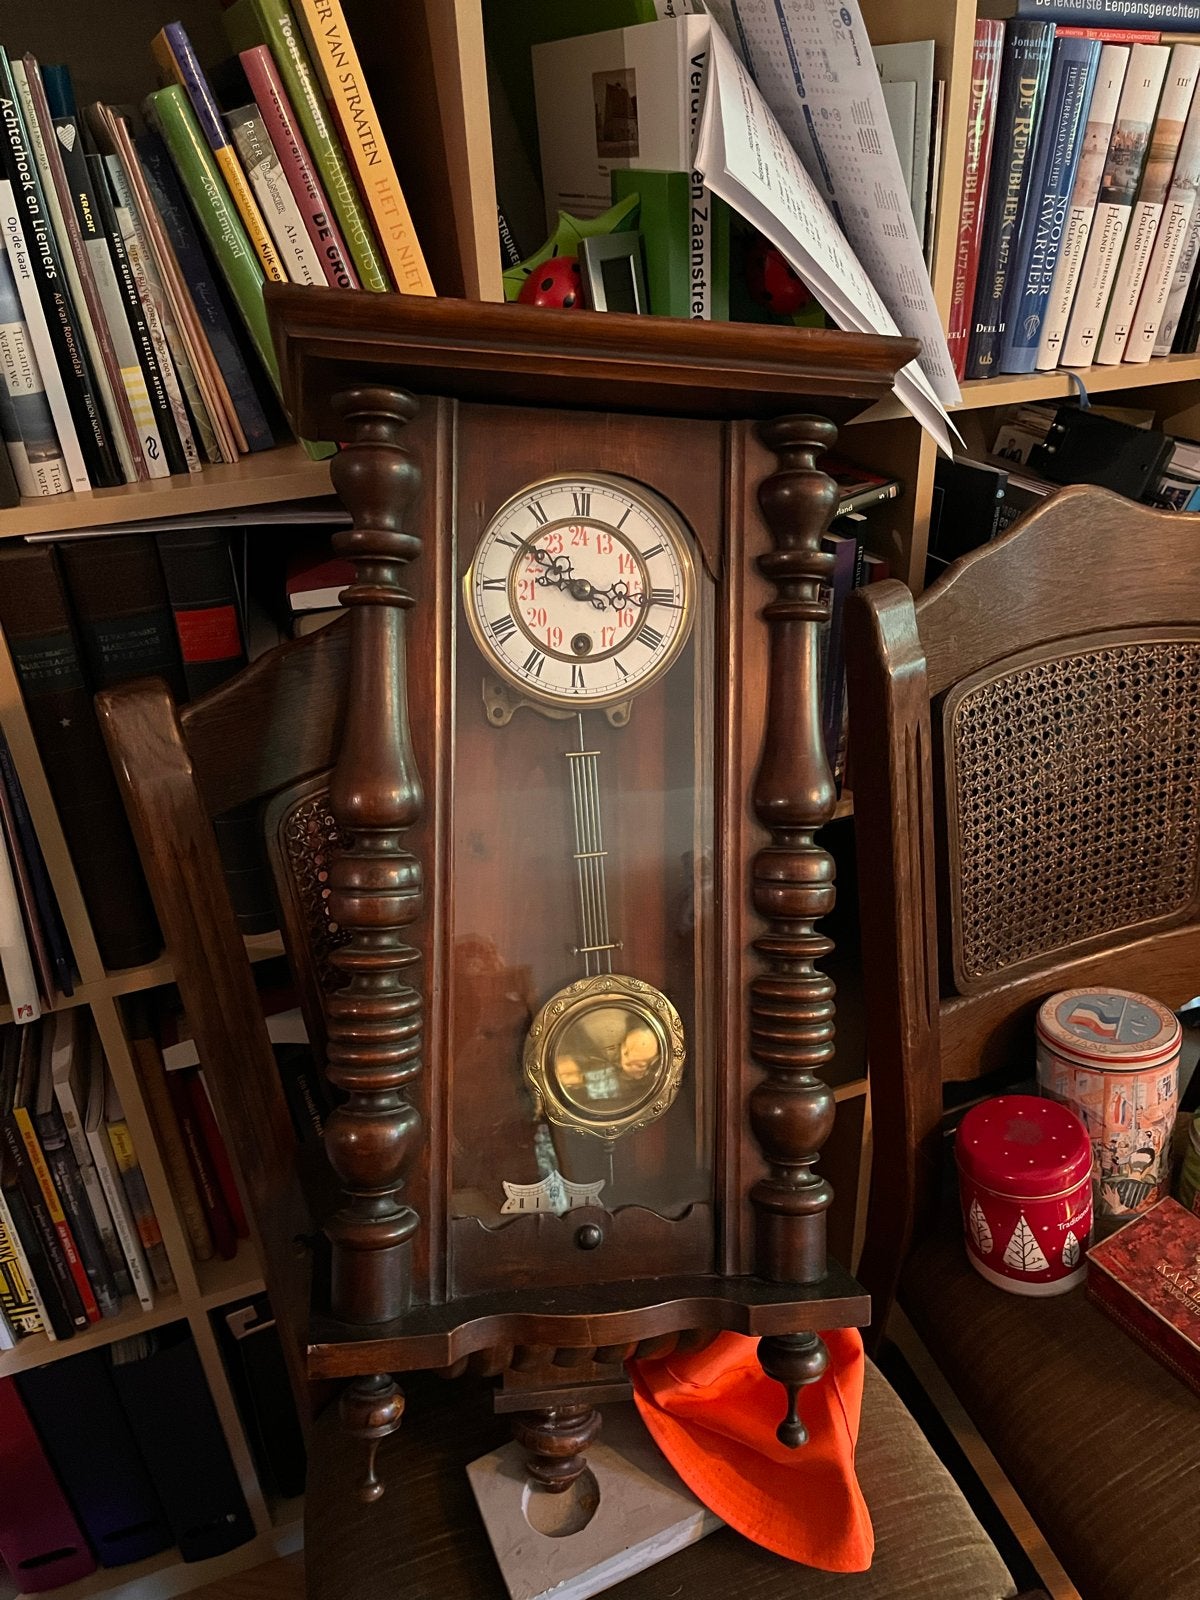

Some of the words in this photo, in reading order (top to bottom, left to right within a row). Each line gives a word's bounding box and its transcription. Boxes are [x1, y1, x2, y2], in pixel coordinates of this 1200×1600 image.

[1053, 0, 1102, 10] lekkerste
[1105, 0, 1200, 18] Eenpansgerechten
[1068, 66, 1077, 88] HET
[970, 79, 988, 110] DE
[1016, 76, 1038, 110] DE
[1058, 90, 1072, 142] VERRAAD
[1, 98, 34, 191] Achterhoek
[278, 14, 300, 59] Toon
[323, 149, 368, 246] VANDAAG
[362, 248, 379, 270] IS
[324, 25, 349, 68] VAN
[339, 73, 382, 166] STRAATEN
[375, 177, 399, 216] HET
[390, 224, 406, 240] IS
[398, 245, 422, 288] NIET
[1054, 143, 1063, 164] VAN
[961, 117, 985, 235] REPUBLIEK
[1001, 117, 1029, 230] REPUBLIEK
[1050, 166, 1059, 188] HET
[26, 194, 40, 215] en
[241, 119, 265, 157] PETER
[258, 160, 288, 215] BLANKER
[283, 222, 299, 244] Als
[293, 246, 306, 261] de
[7, 216, 17, 233] Op
[79, 193, 96, 233] KRACHT
[290, 139, 302, 162] van
[311, 210, 333, 241] DE
[325, 244, 353, 289] GRO
[1162, 202, 1183, 250] HOLLAND
[13, 235, 22, 249] de
[211, 207, 247, 259] Ermgard
[1098, 205, 1118, 254] HOLLAND
[1133, 204, 1153, 252] HOLLAND
[32, 219, 57, 279] Liemers
[110, 231, 125, 259] ARNON
[259, 242, 276, 264] Kijk
[1025, 193, 1055, 298] KWARTIER
[1038, 194, 1067, 298] NOORDER
[1099, 219, 1122, 290] GESCHIEDENIS
[1133, 217, 1156, 287] GESCHIEDENIS
[1162, 216, 1186, 286] GESCHIEDENIS
[17, 252, 31, 279] kaart
[952, 239, 969, 305] 1477-1806
[991, 234, 1011, 300] 1477-1806
[54, 292, 63, 305] Ad
[118, 263, 139, 305] GRUNBERG
[1128, 288, 1136, 306] VAN
[1156, 286, 1165, 304] VAN
[140, 287, 160, 329] VERLOREN
[1094, 291, 1103, 308] VAN
[59, 306, 68, 324] van
[136, 320, 145, 331] DE
[976, 323, 997, 333] DEEL
[999, 323, 1006, 332] II
[0, 330, 16, 368] waren
[10, 370, 20, 388] we
[13, 327, 34, 389] Titaantjes
[63, 325, 85, 378] Roosendaal
[139, 335, 157, 370] HEILIGE
[84, 394, 94, 418] TIRION
[151, 374, 168, 409] ANTONIO
[91, 419, 104, 447] NATUUR
[572, 493, 590, 516] XII
[544, 534, 564, 554] 23
[568, 526, 590, 546] 24
[596, 534, 614, 554] 13
[618, 554, 637, 574] 14
[518, 581, 536, 600] 21
[527, 608, 546, 627] 20
[617, 608, 634, 628] 16
[546, 626, 563, 648] 19
[601, 626, 617, 648] 17
[522, 648, 546, 678] VII
[572, 664, 585, 688] VI
[3, 1126, 15, 1145] ANNE
[10, 1144, 24, 1167] FRANK
[57, 1225, 67, 1238] JAN
[61, 1237, 77, 1263] WOLKERS
